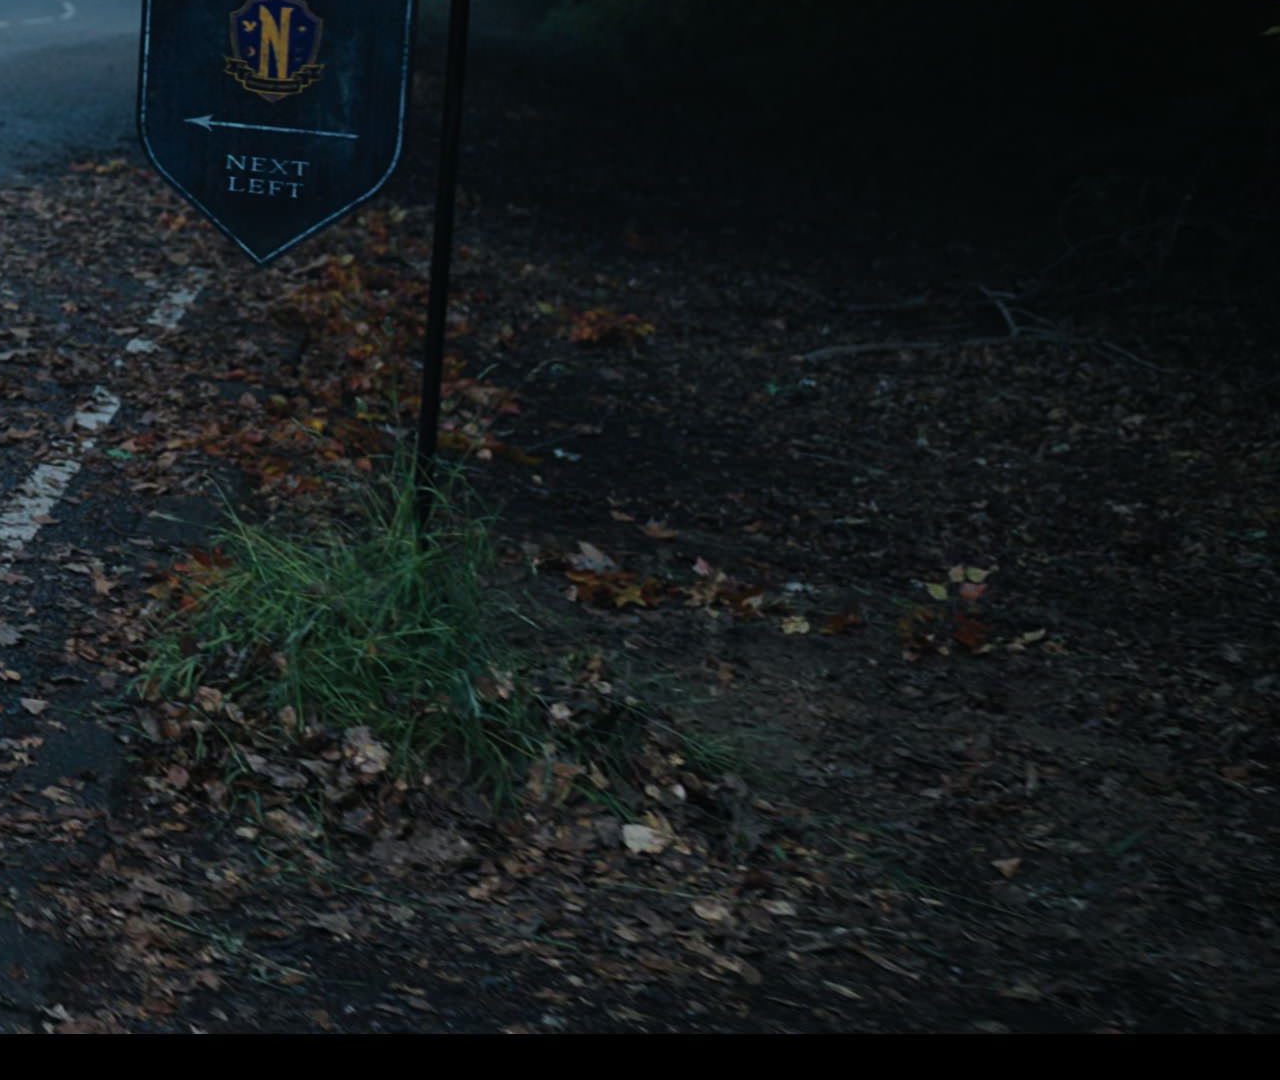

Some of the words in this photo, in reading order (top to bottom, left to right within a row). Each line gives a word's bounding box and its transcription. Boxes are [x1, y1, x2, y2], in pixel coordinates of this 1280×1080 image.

[257, 4, 295, 79] N
[225, 153, 310, 177] NEXT
[227, 176, 305, 199] LEFT
